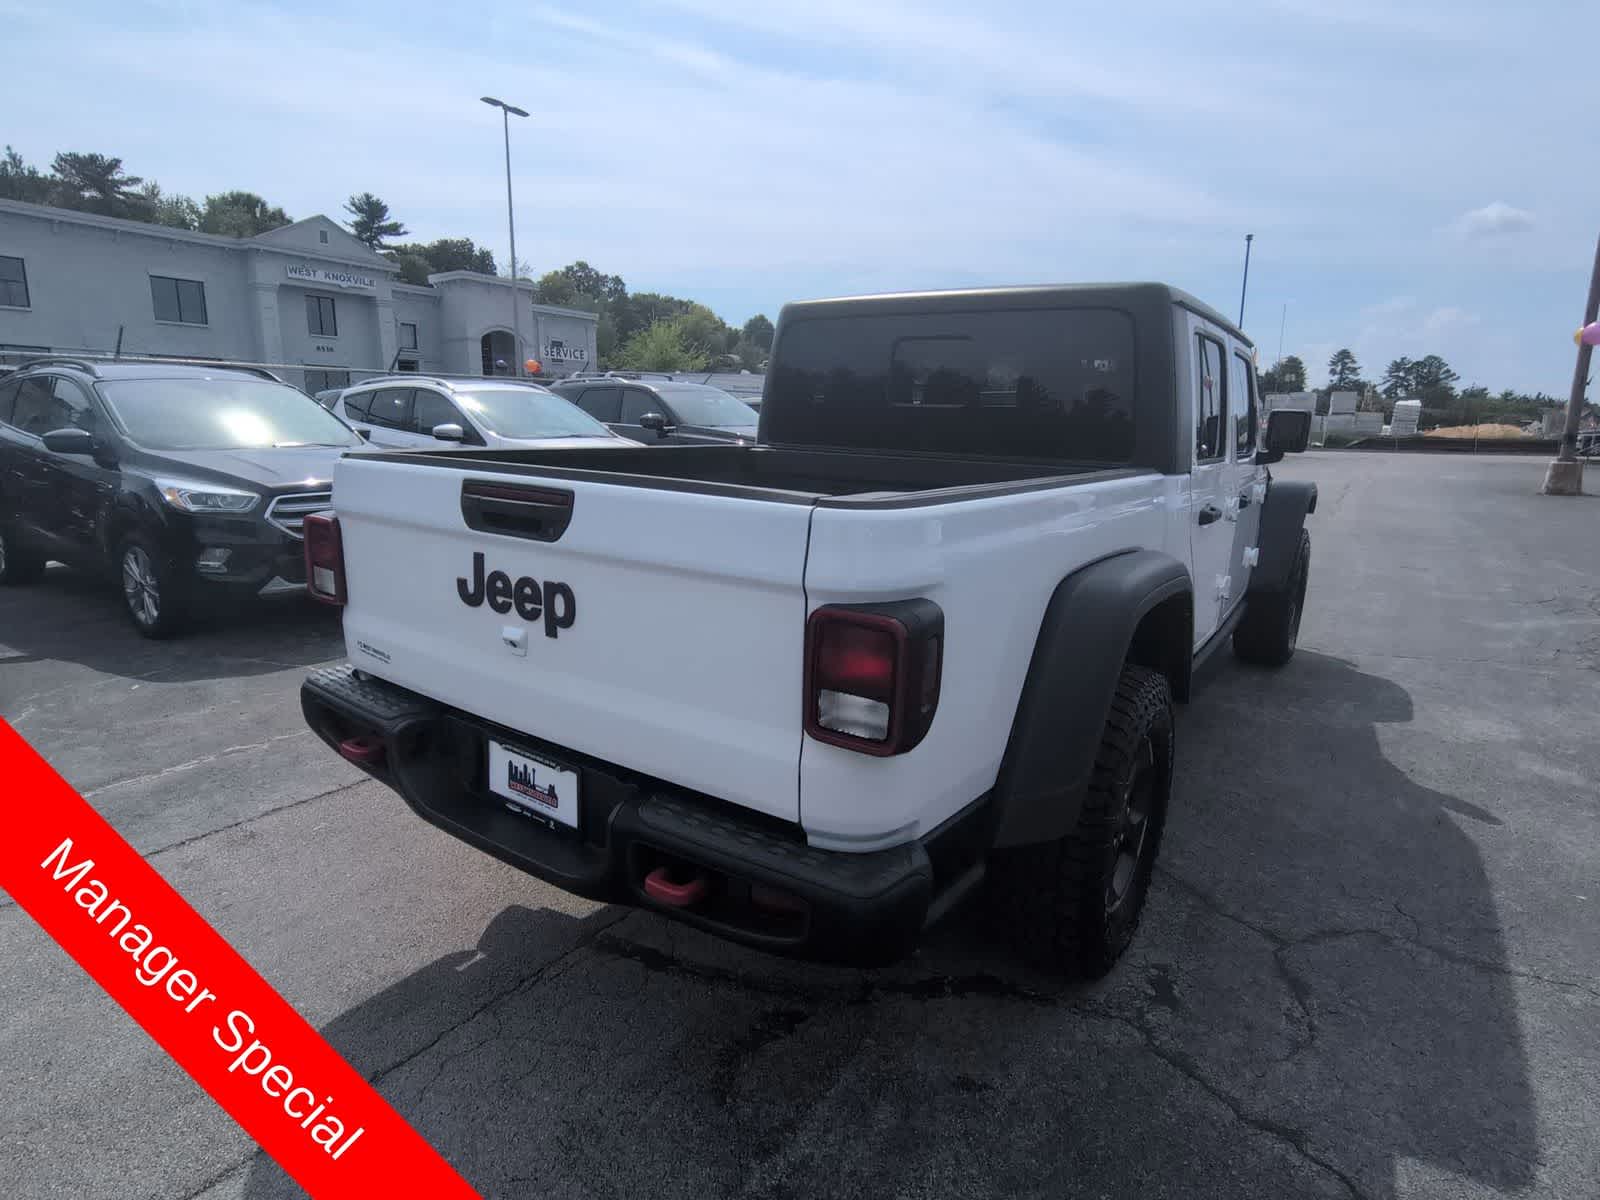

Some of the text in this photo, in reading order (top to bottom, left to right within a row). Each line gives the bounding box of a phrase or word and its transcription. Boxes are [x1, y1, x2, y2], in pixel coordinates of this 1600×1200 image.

[288, 265, 317, 278] WEST
[544, 345, 585, 360] SERVICE
[456, 552, 576, 639] Jeep
